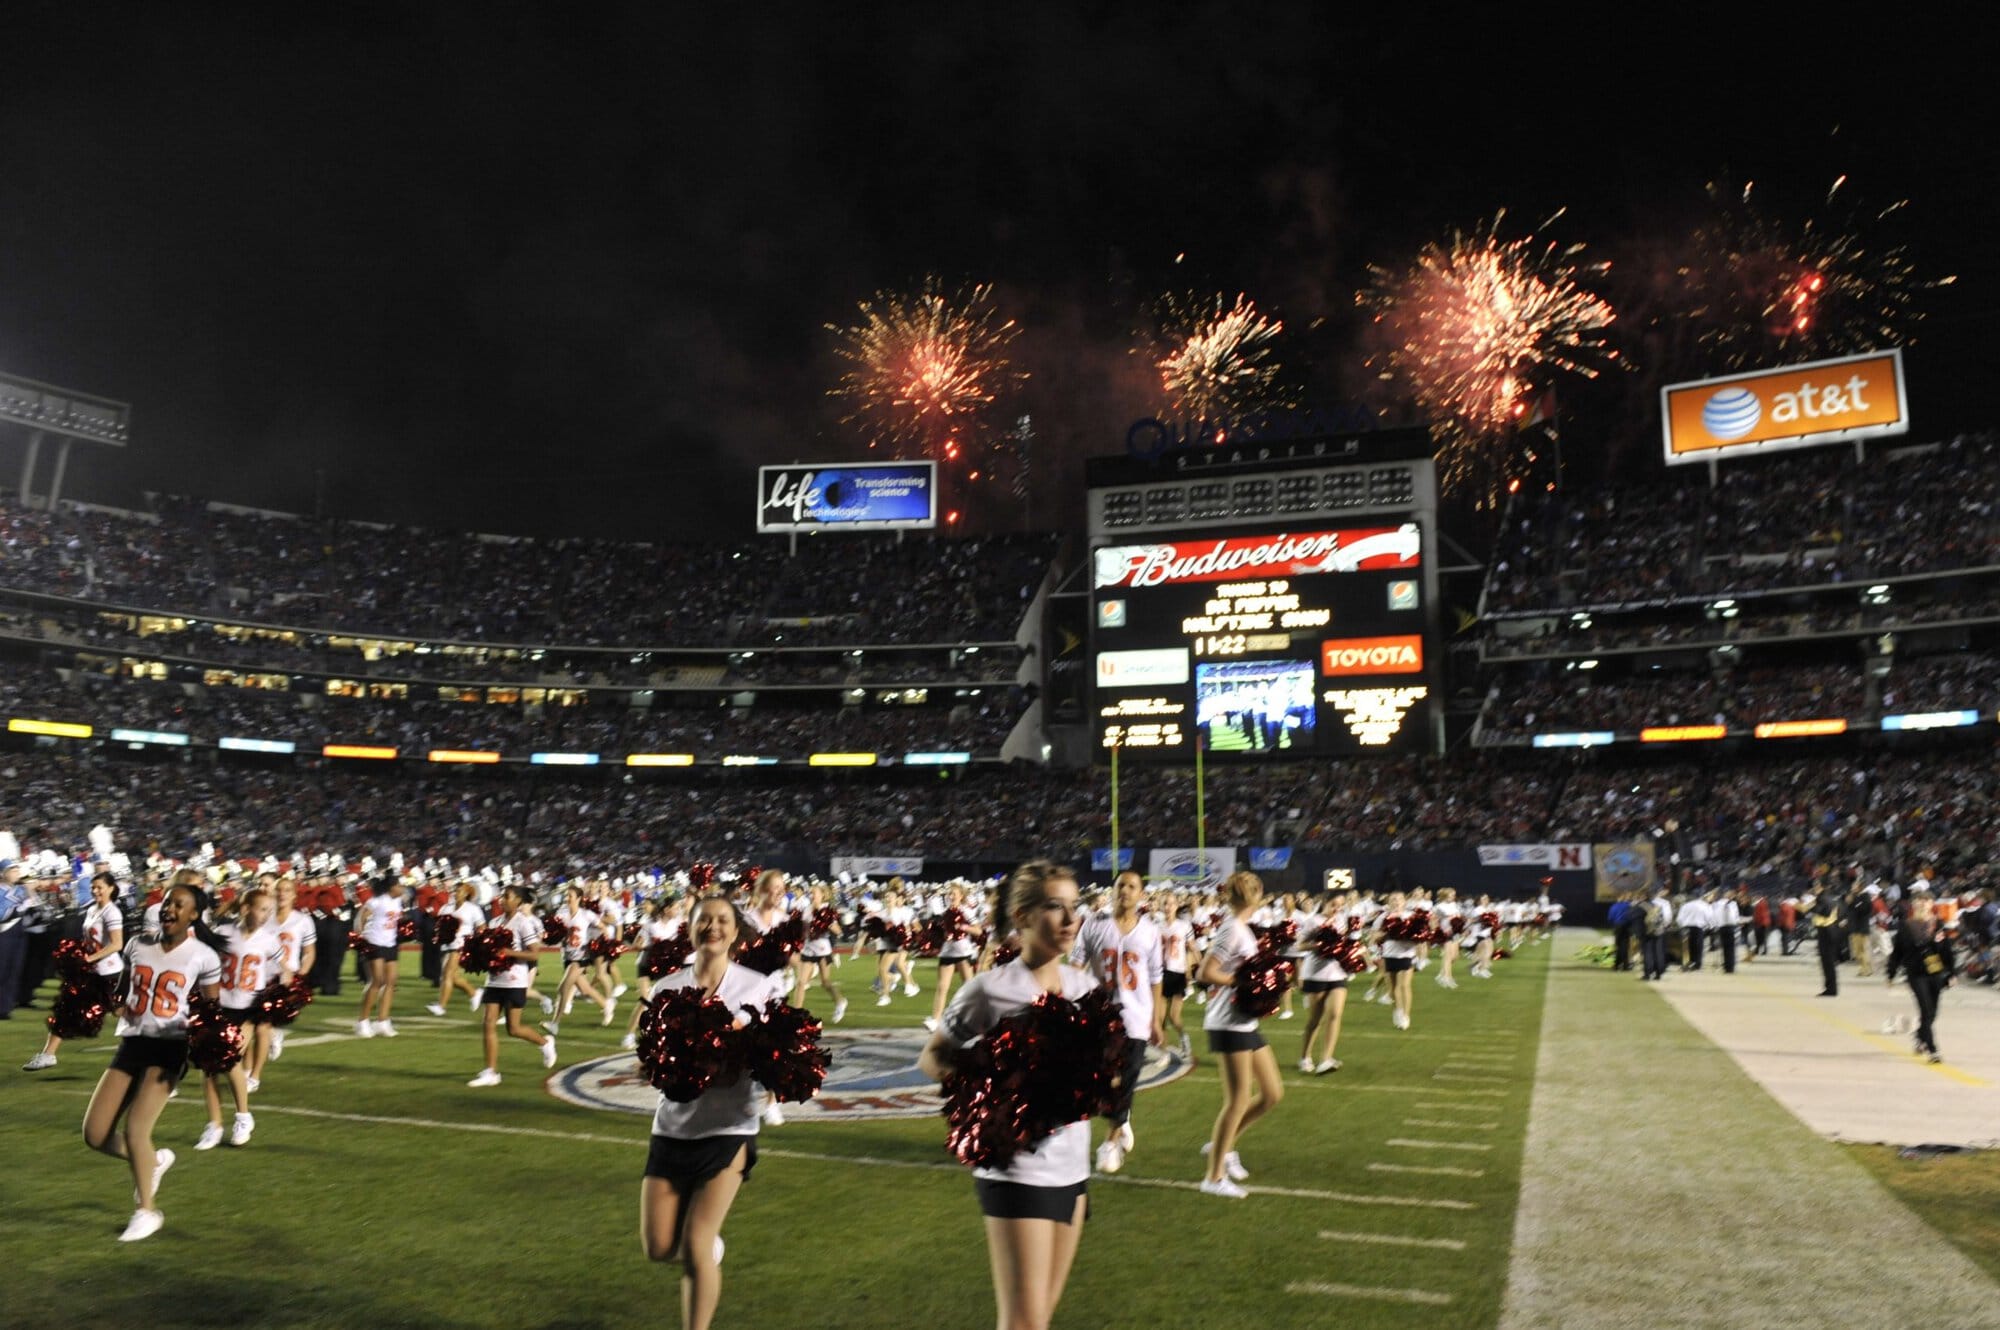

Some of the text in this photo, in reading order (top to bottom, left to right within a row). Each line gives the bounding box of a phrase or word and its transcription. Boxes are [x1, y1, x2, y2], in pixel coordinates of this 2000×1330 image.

[1771, 374, 1870, 423] at&t
[1176, 439, 1360, 468] STADIUM
[855, 477, 926, 489] Transforming
[869, 488, 910, 498] science
[763, 472, 822, 522] life
[803, 506, 867, 520] technologies
[1125, 533, 1338, 588] Budweiser
[1326, 645, 1418, 668] TOYOTA
[1558, 847, 1582, 867] N
[1327, 868, 1353, 889] 25
